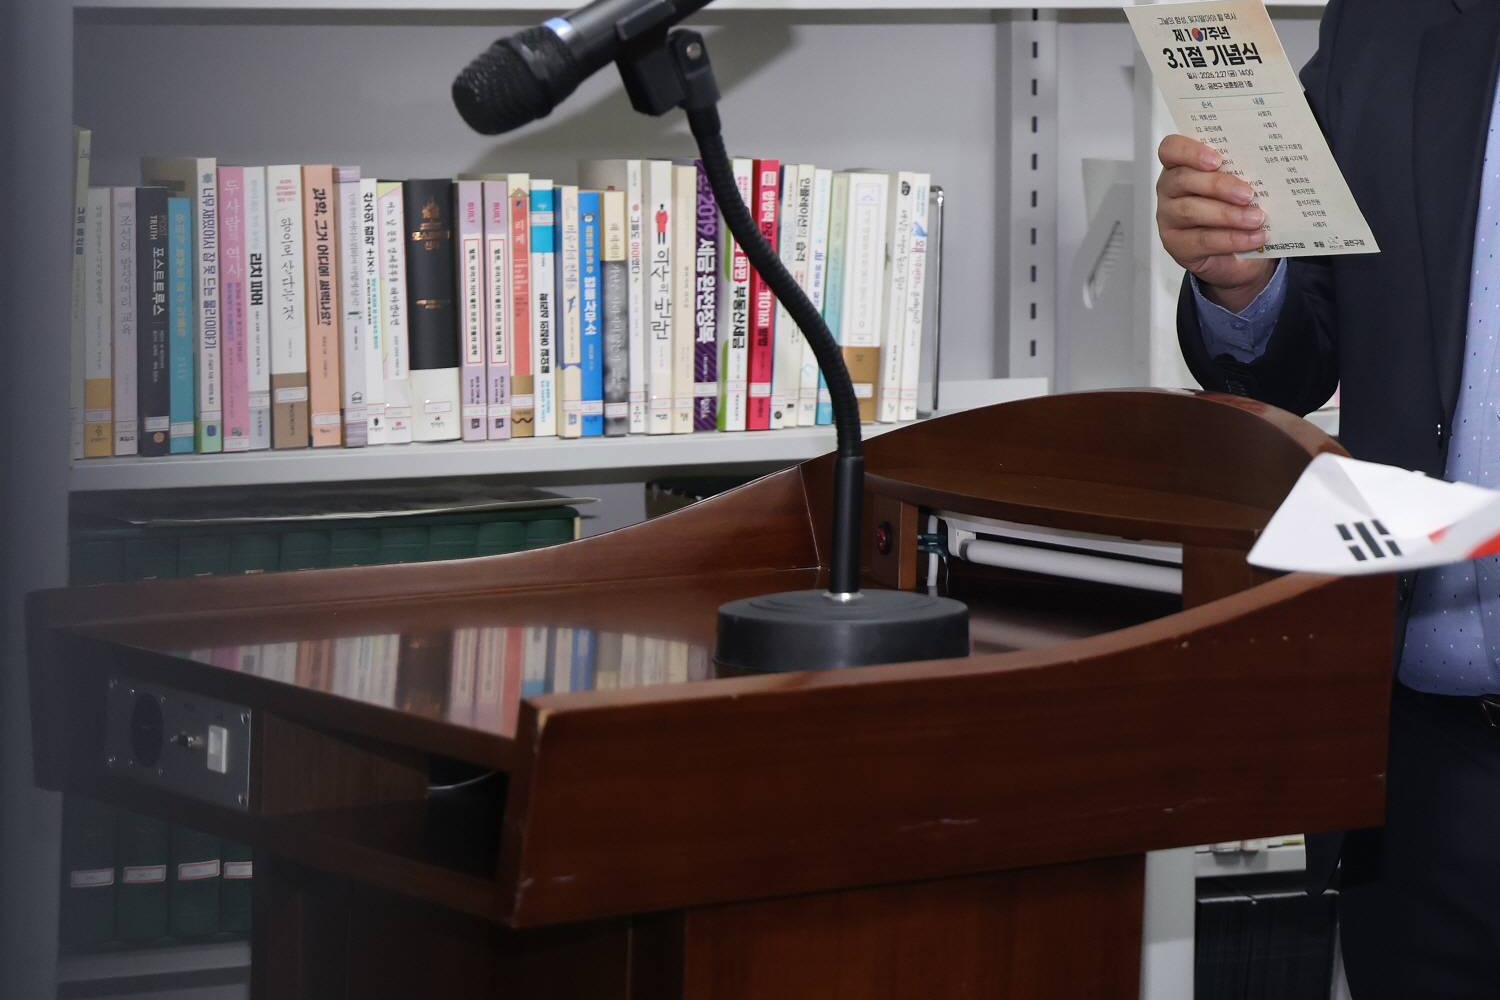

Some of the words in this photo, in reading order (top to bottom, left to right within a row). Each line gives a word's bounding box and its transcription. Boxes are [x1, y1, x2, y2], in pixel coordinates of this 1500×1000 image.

[1157, 17, 1175, 26] 그날의
[1224, 12, 1238, 21] 역사
[1162, 46, 1208, 69] 3.1절
[1206, 42, 1263, 67] 기념식
[1252, 97, 1266, 106] 내용
[1257, 110, 1273, 118] 사회자
[1262, 121, 1278, 129] 사회자
[1268, 133, 1283, 141] 사회자
[202, 187, 215, 207] 너무
[224, 180, 240, 196] 두
[312, 187, 327, 217] 과학,
[467, 202, 476, 224] BUILT
[492, 202, 501, 224] BUILT
[696, 193, 716, 235] 2019
[795, 177, 812, 238] 인플레이션의
[149, 215, 158, 240] TRUTH
[202, 208, 216, 250] 재밌어서
[224, 198, 242, 242] 사람의
[315, 219, 329, 241] 그거
[631, 215, 641, 239] 그들도
[202, 252, 216, 263] 잠
[226, 246, 243, 279] 역사
[316, 244, 331, 277] 어디에
[697, 237, 716, 274] 세금
[794, 240, 807, 262] 습격
[203, 264, 216, 275] 못
[249, 252, 264, 278] 리치
[650, 247, 670, 293] 의사의
[152, 246, 166, 316] 포스트트루스
[203, 277, 217, 296] 드는
[250, 280, 264, 306] 파머
[318, 279, 332, 326] 써먹나요?
[696, 275, 716, 344] 완전정복
[203, 299, 218, 349] 물리이야기
[650, 297, 672, 341] 반란
[732, 286, 746, 349] 부동산세금
